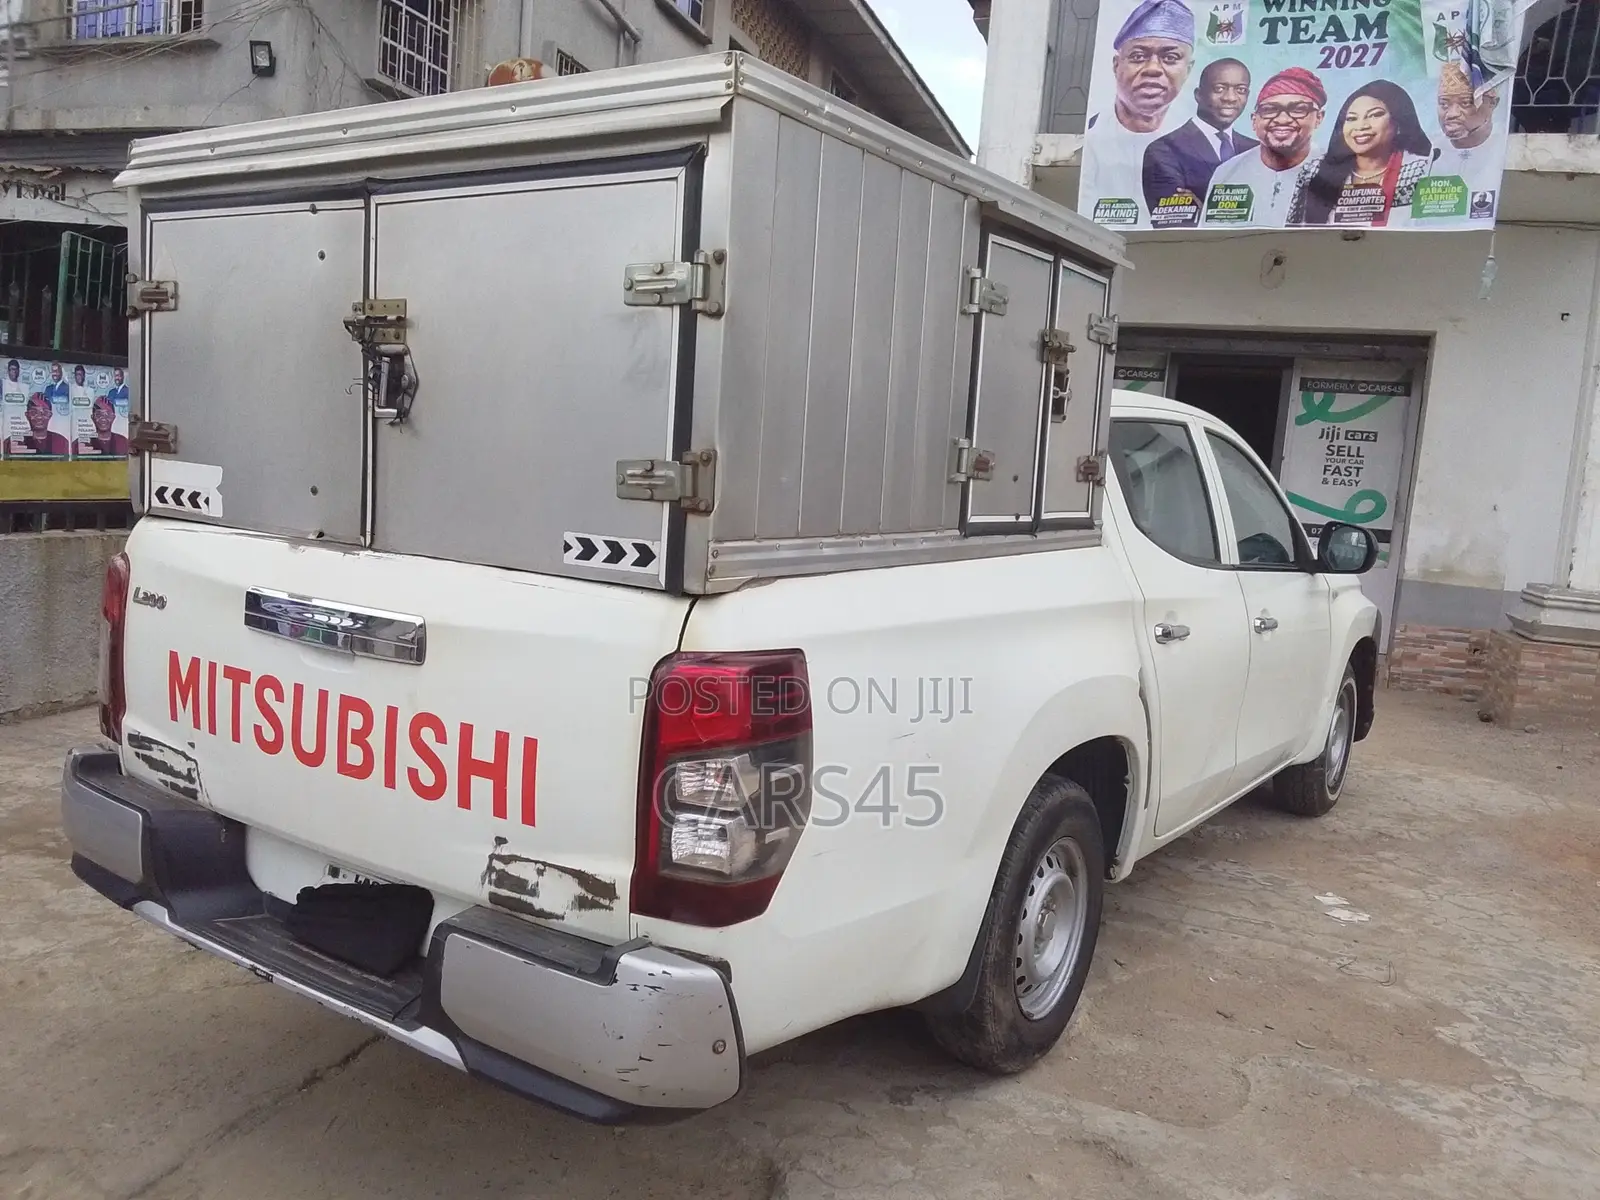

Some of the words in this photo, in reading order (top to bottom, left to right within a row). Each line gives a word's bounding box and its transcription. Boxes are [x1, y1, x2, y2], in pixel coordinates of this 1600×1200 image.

[1259, 11, 1390, 44] TEAM
[1317, 42, 1388, 69] 2027
[1158, 196, 1193, 207] BIMBO
[1095, 209, 1138, 218] MAKINDE
[1307, 380, 1356, 391] FORMERLY
[1347, 431, 1376, 441] cars
[1325, 444, 1365, 458] SELL
[1325, 457, 1347, 465] YOUR
[1348, 458, 1365, 466] CAR
[1323, 464, 1364, 478] FAST
[1321, 477, 1330, 486] &
[1332, 478, 1362, 487] EASY
[168, 650, 539, 828] MITSUBISHI
